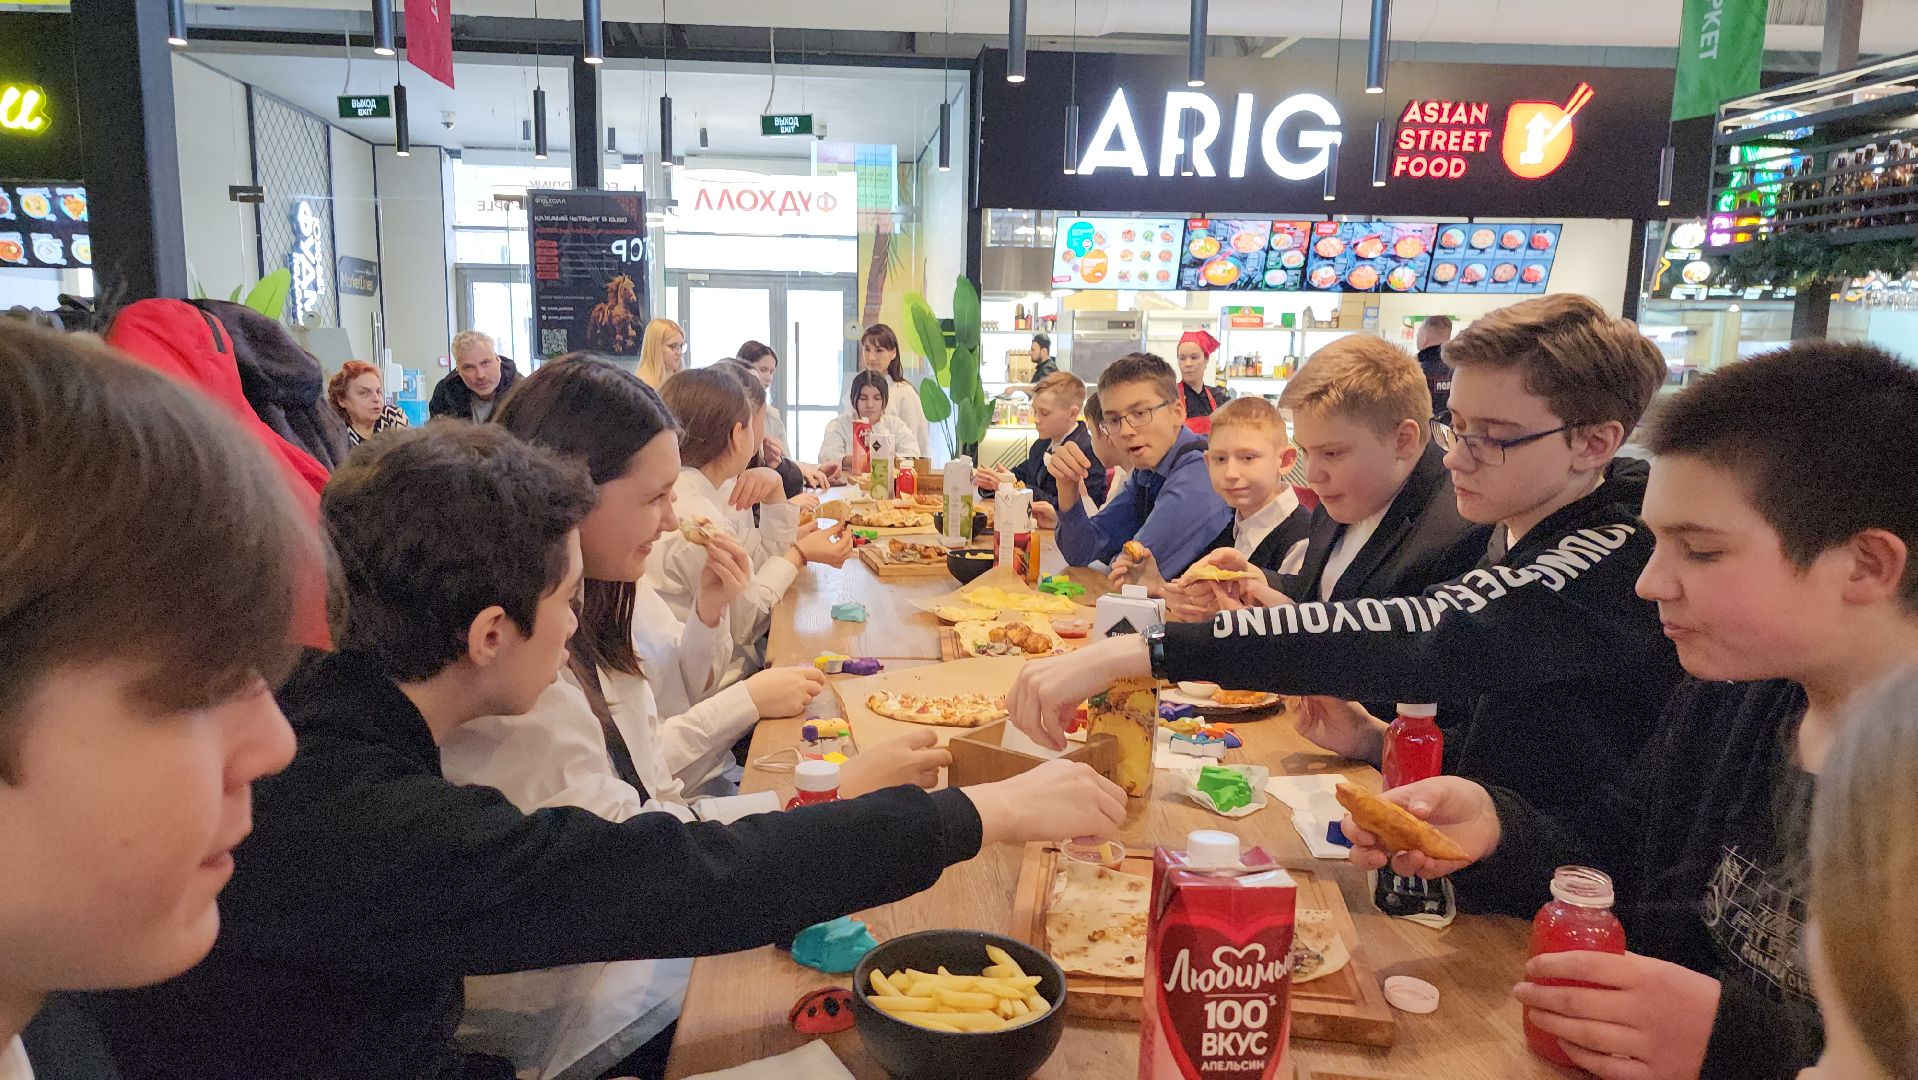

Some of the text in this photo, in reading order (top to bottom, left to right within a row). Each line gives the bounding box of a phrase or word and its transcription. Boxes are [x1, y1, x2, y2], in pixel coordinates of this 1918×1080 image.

[351, 98, 377, 110] ВЫХОД
[357, 108, 374, 117] EXIT
[1402, 100, 1490, 125] ASIAN
[774, 116, 800, 128] ВЫХОД
[1077, 87, 1342, 181] ARIG
[1398, 128, 1493, 153] STREET
[1393, 154, 1468, 179] FOOD
[1201, 1031, 1269, 1057] ВКУС
[1201, 1060, 1265, 1072] АПЕЛЬСИН
